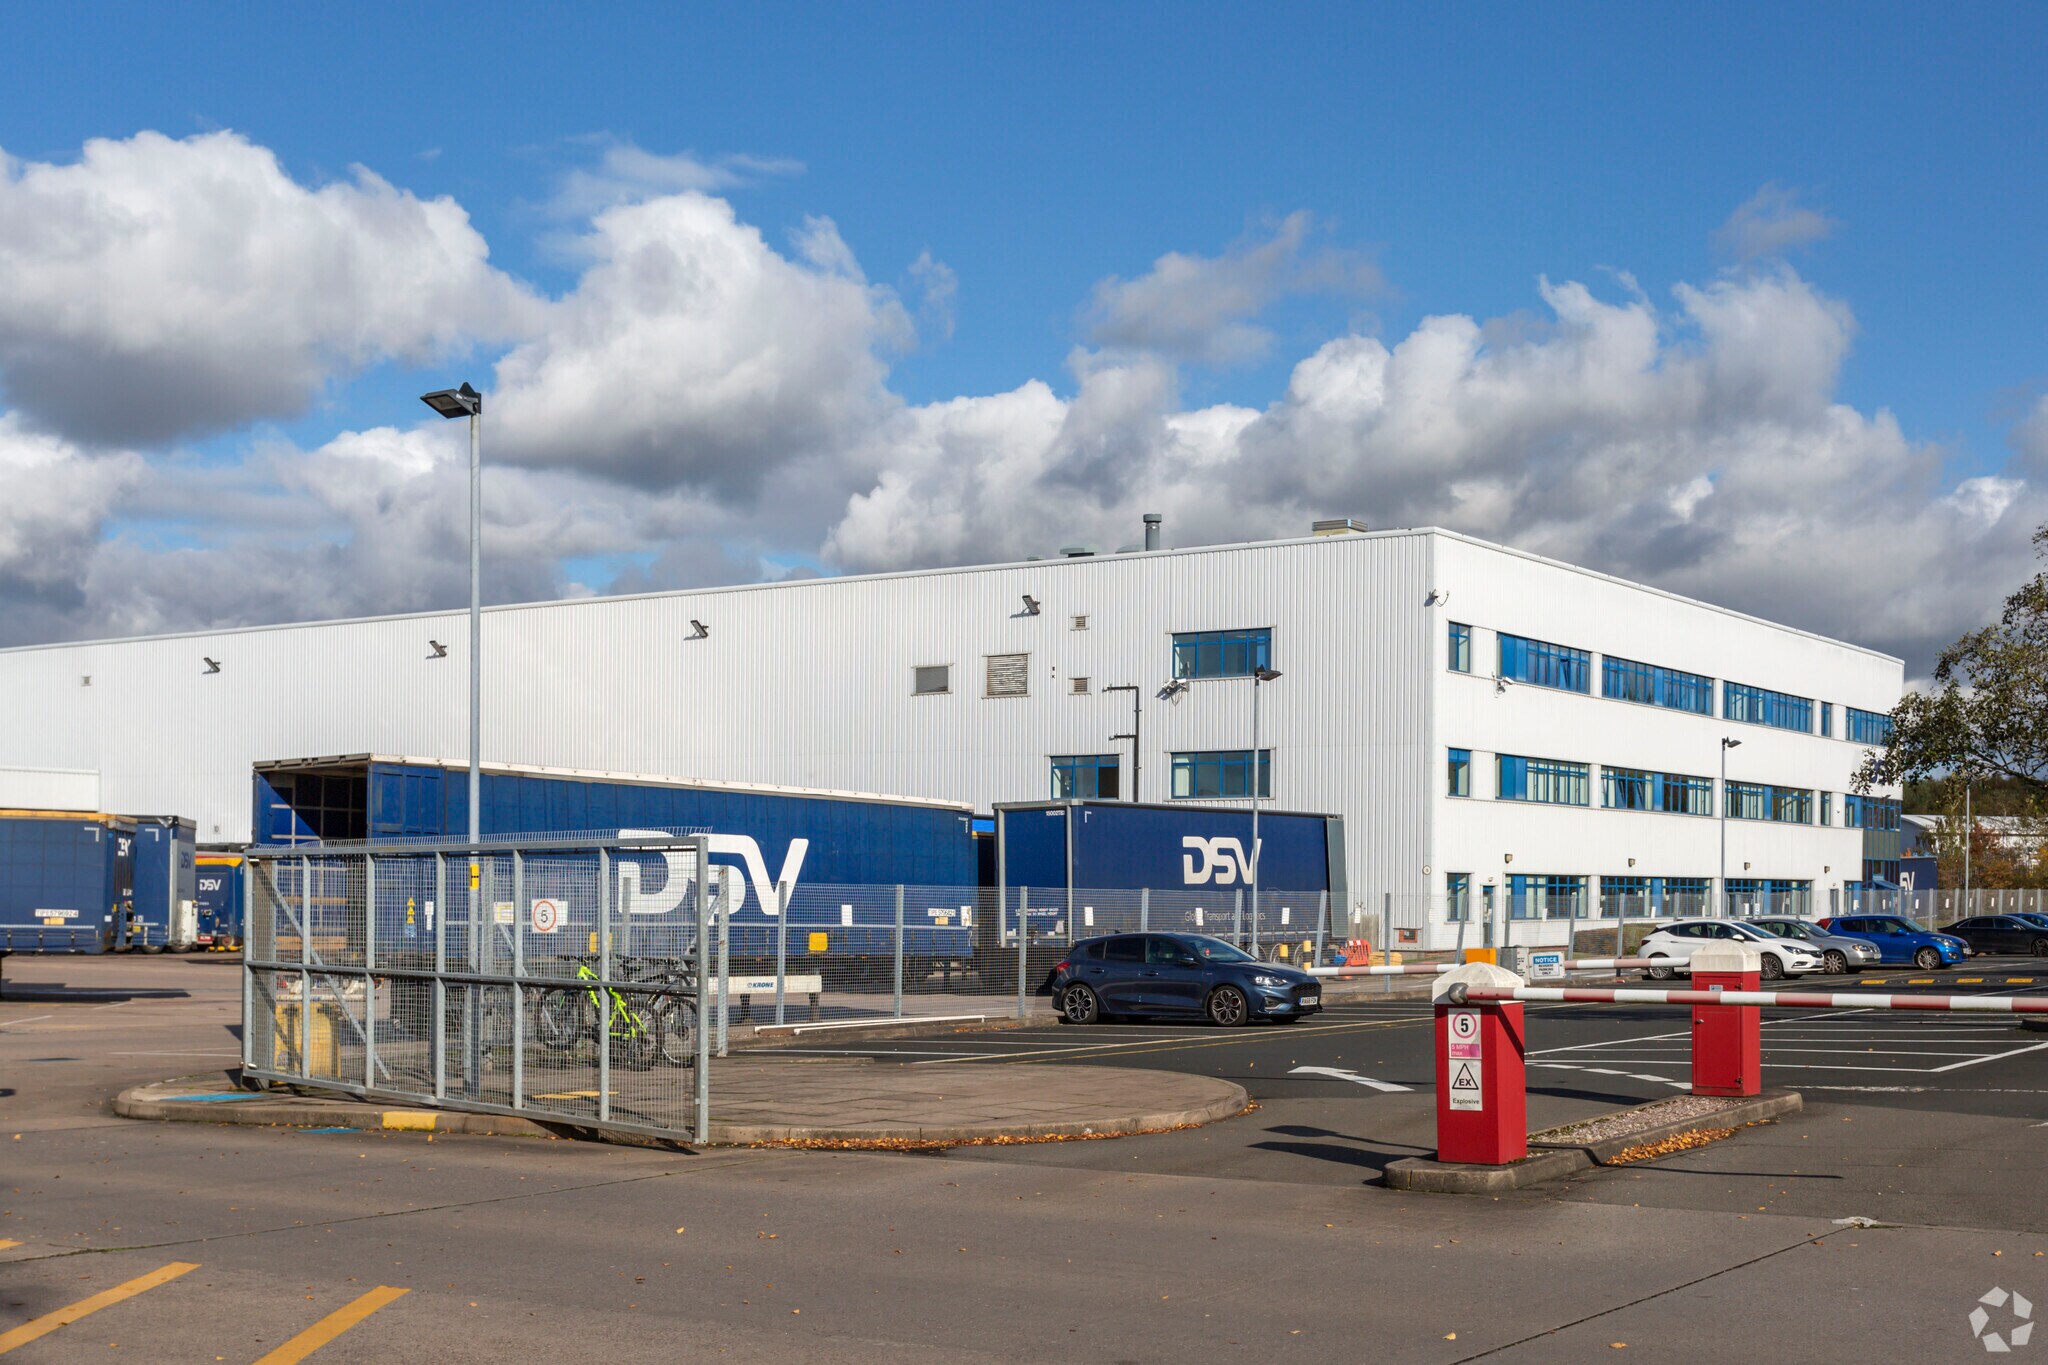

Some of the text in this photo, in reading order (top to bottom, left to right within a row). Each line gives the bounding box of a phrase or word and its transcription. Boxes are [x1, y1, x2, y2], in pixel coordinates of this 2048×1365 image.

[1183, 836, 1262, 884] DSV
[618, 829, 809, 915] DSV
[199, 879, 221, 891] DSV
[1900, 872, 1915, 894] SV
[541, 910, 548, 923] 5
[1460, 1018, 1469, 1032] 5
